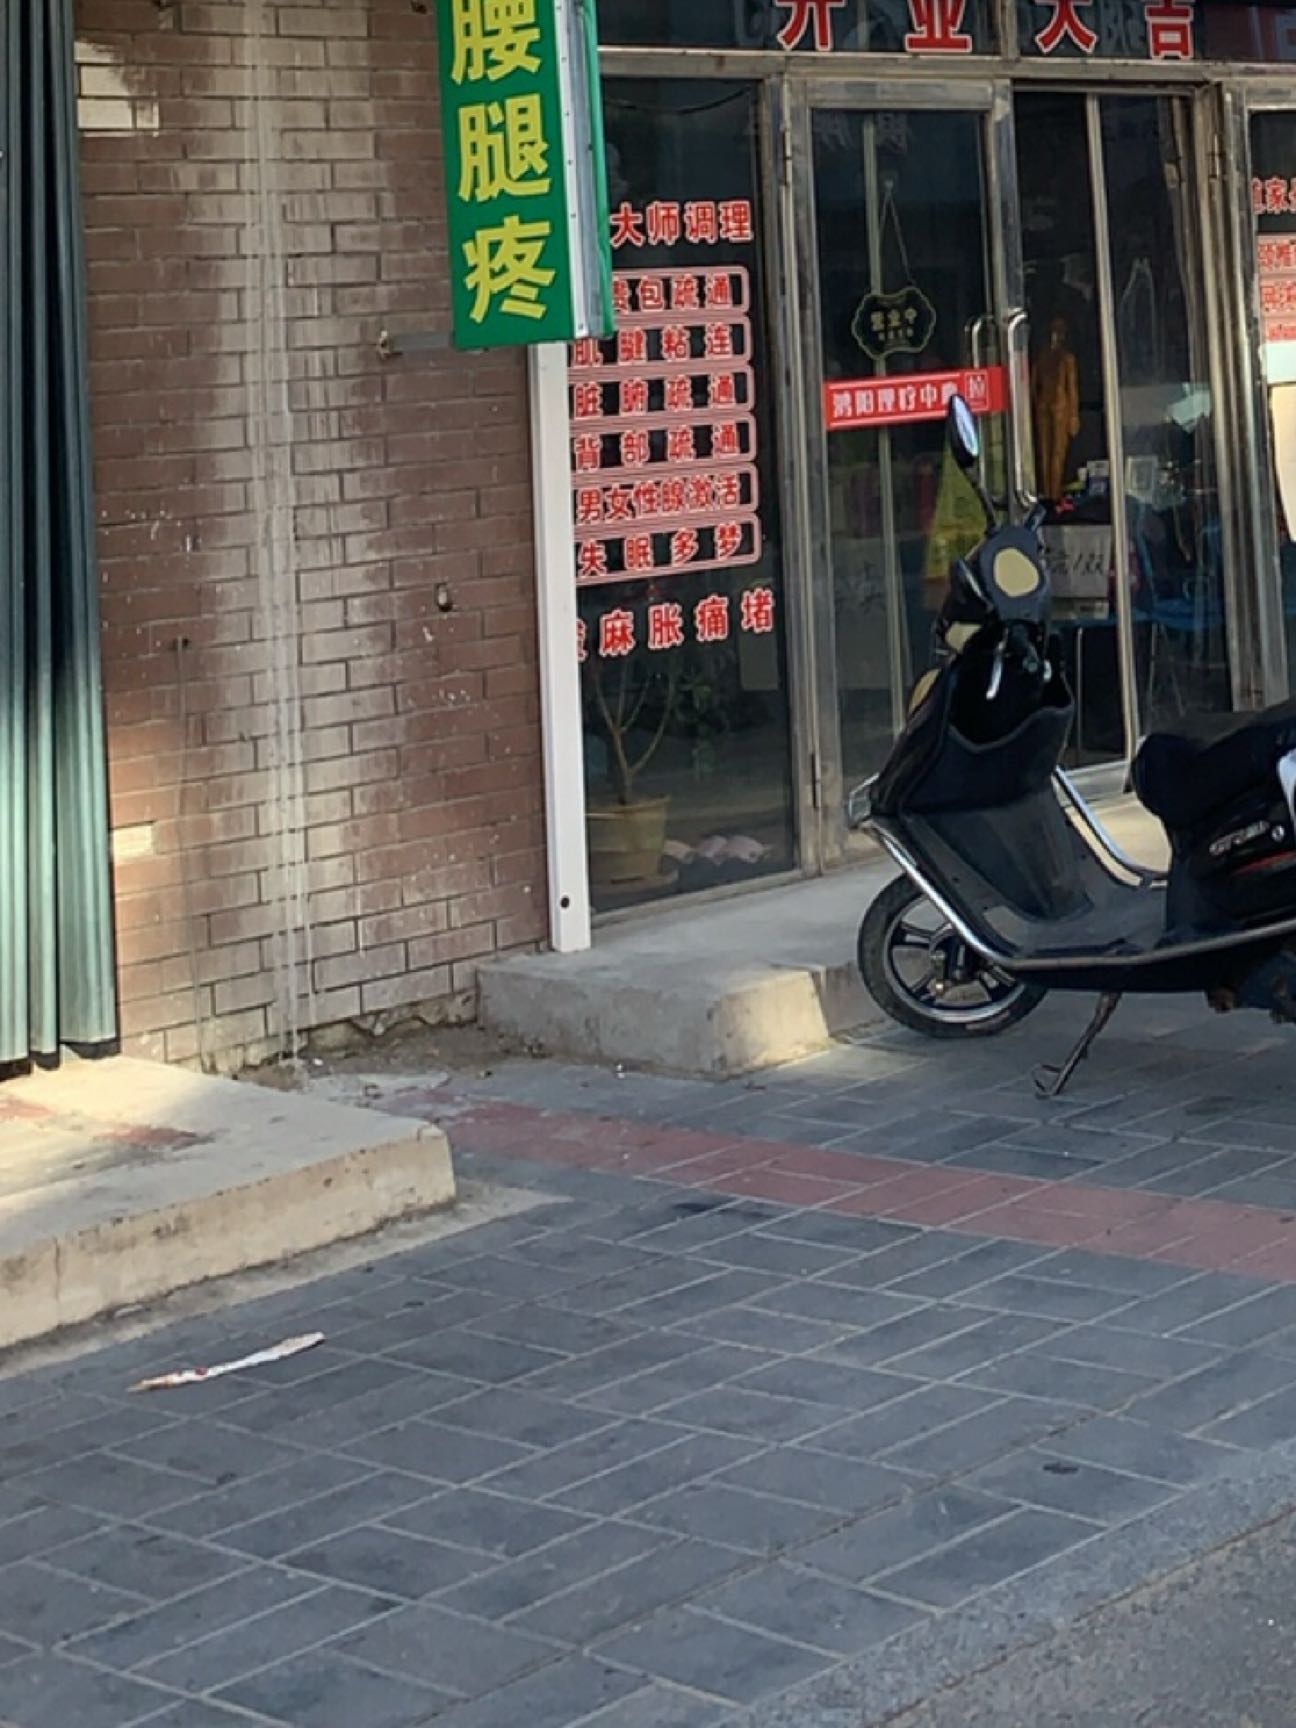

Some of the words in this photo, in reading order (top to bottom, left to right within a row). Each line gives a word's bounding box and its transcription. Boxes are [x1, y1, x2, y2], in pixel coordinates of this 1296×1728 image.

[611, 200, 754, 249] 大师调理
[579, 523, 742, 576] 失眠多梦
